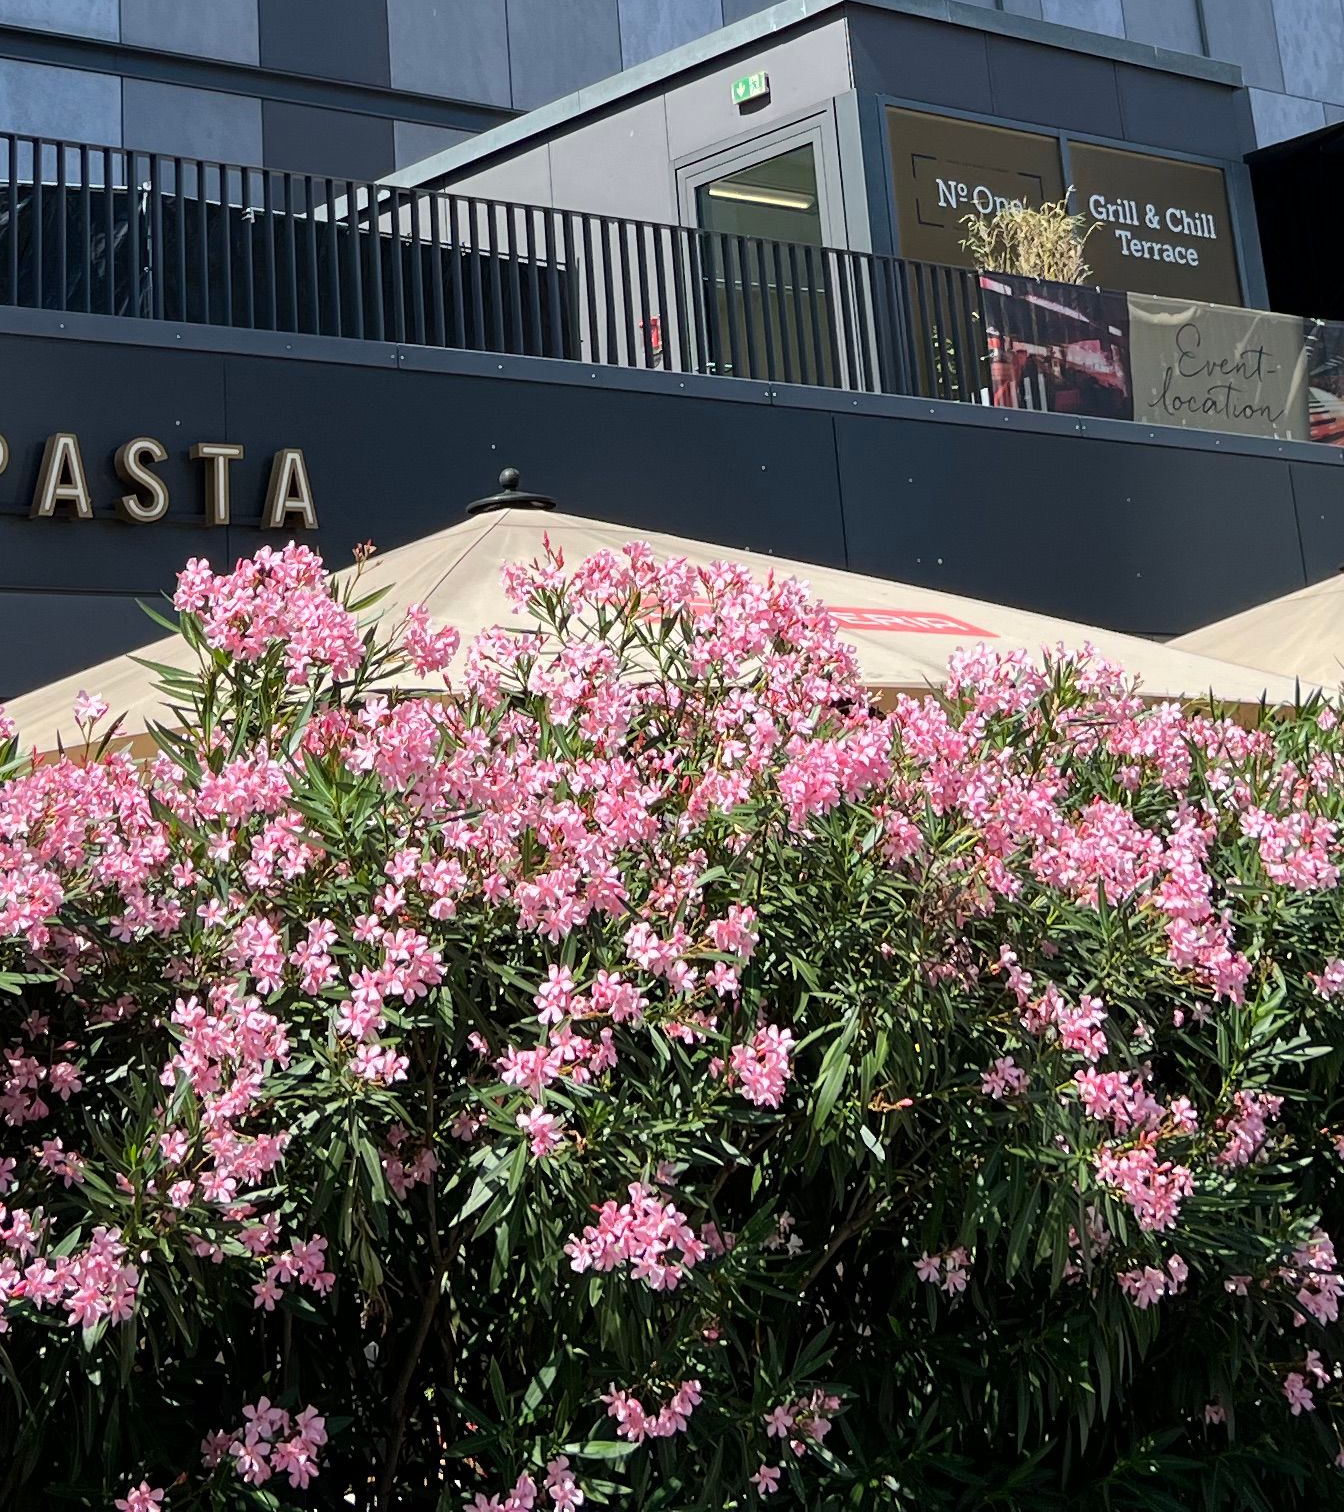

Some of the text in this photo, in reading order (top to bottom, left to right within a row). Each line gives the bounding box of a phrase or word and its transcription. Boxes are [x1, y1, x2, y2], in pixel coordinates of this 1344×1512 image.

[1089, 194, 1217, 240] Grill & Chill
[1115, 228, 1199, 267] Terrace
